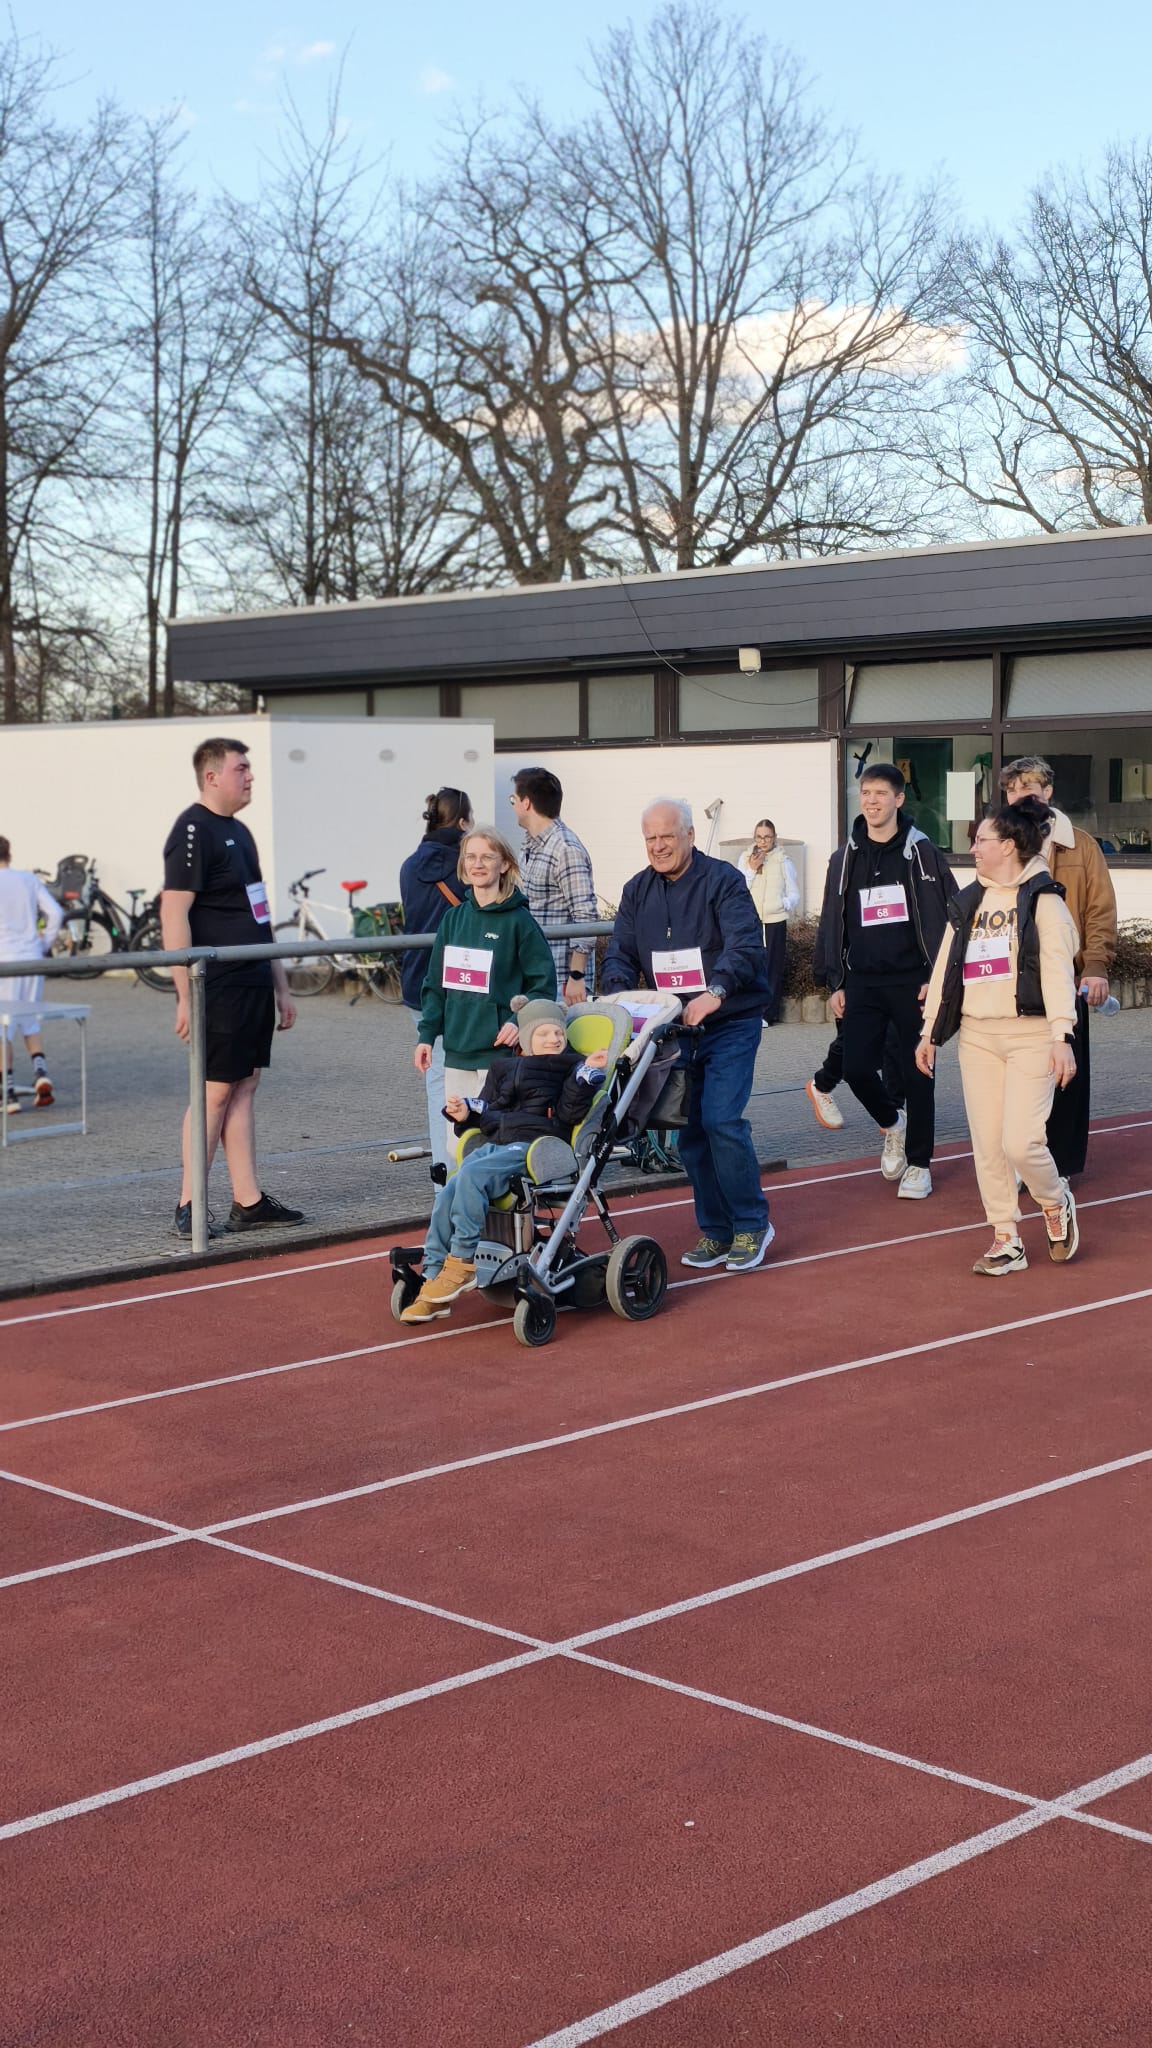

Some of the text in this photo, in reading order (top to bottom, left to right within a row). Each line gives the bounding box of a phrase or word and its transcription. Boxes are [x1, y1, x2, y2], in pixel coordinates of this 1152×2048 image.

[876, 907, 889, 918] 68
[979, 963, 993, 975] 70
[458, 972, 472, 984] 36
[670, 975, 683, 986] 37
